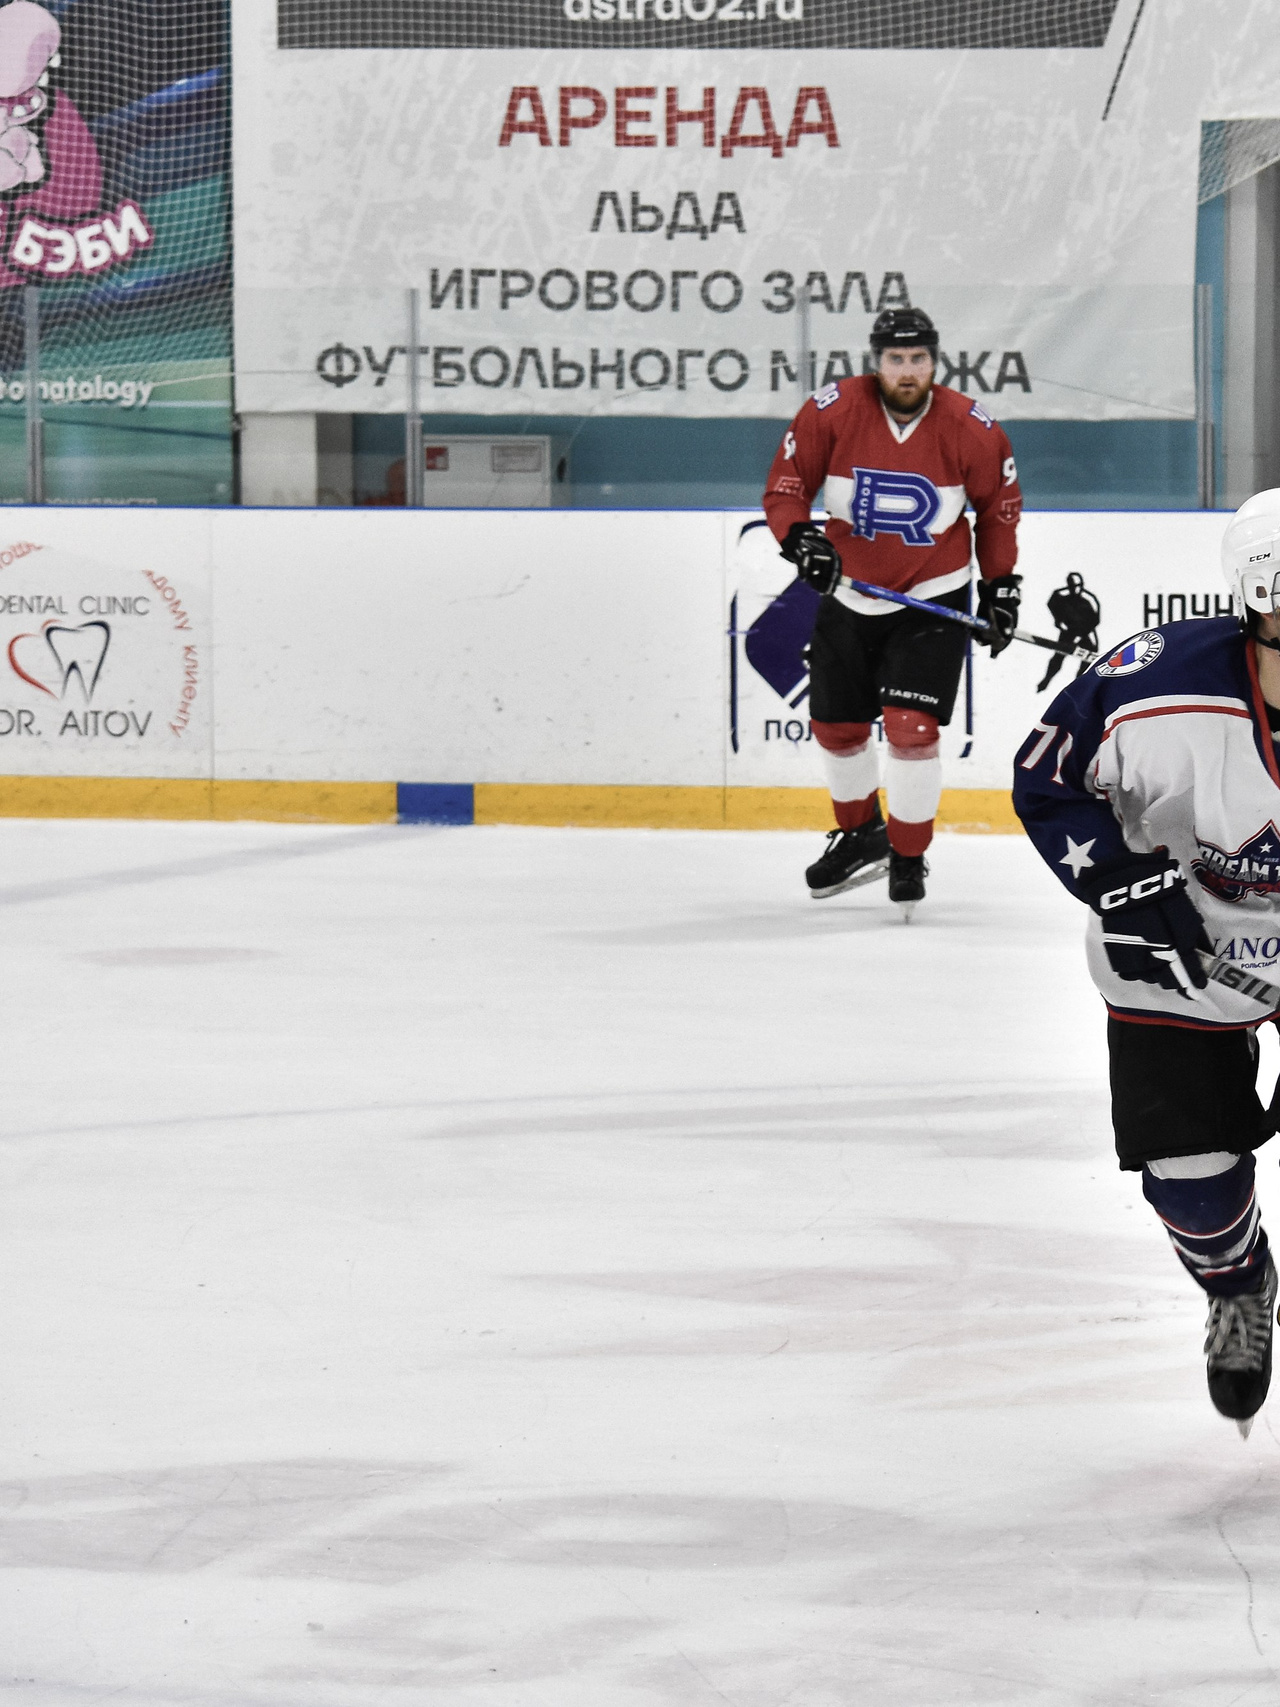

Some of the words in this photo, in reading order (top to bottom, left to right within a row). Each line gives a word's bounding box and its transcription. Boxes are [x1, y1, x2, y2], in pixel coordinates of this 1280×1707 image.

[498, 86, 840, 157] АРЕНДА
[590, 191, 746, 240] ЛЬДА
[13, 205, 150, 273] БЭБИ
[428, 268, 743, 313] ИГРОВОГО
[762, 270, 913, 314] ЗАЛА
[769, 348, 1032, 393] МАЖА
[1249, 552, 1272, 563] CCM
[79, 595, 150, 616] CLINIC
[889, 688, 939, 705] EASTON
[58, 709, 153, 737] AITOV
[1100, 865, 1186, 910] CCM
